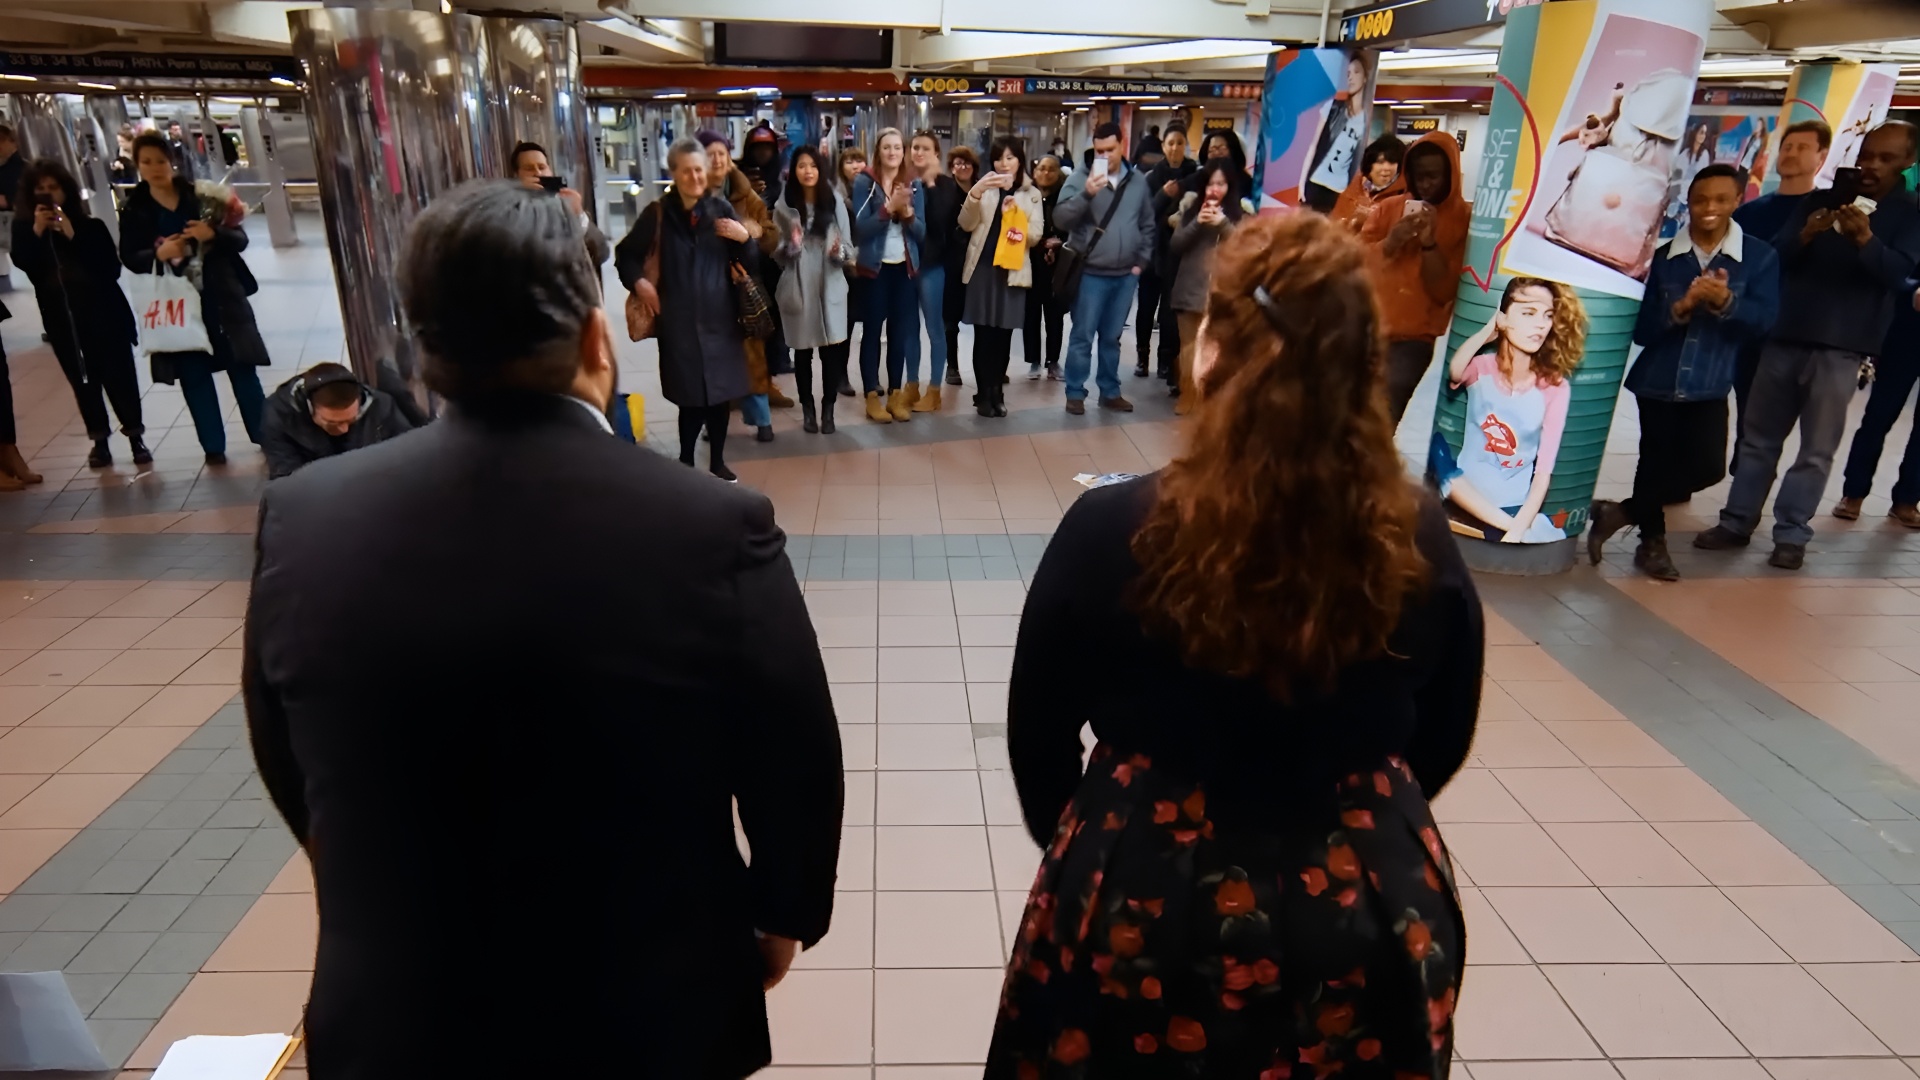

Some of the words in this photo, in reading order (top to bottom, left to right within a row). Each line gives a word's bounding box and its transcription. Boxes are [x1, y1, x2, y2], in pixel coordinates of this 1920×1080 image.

[9, 54, 26, 65] 33
[997, 80, 1021, 94] Exit
[1036, 80, 1046, 90] 33
[1060, 81, 1070, 90] 34
[1171, 84, 1188, 93] MSG
[1483, 128, 1517, 158] SE
